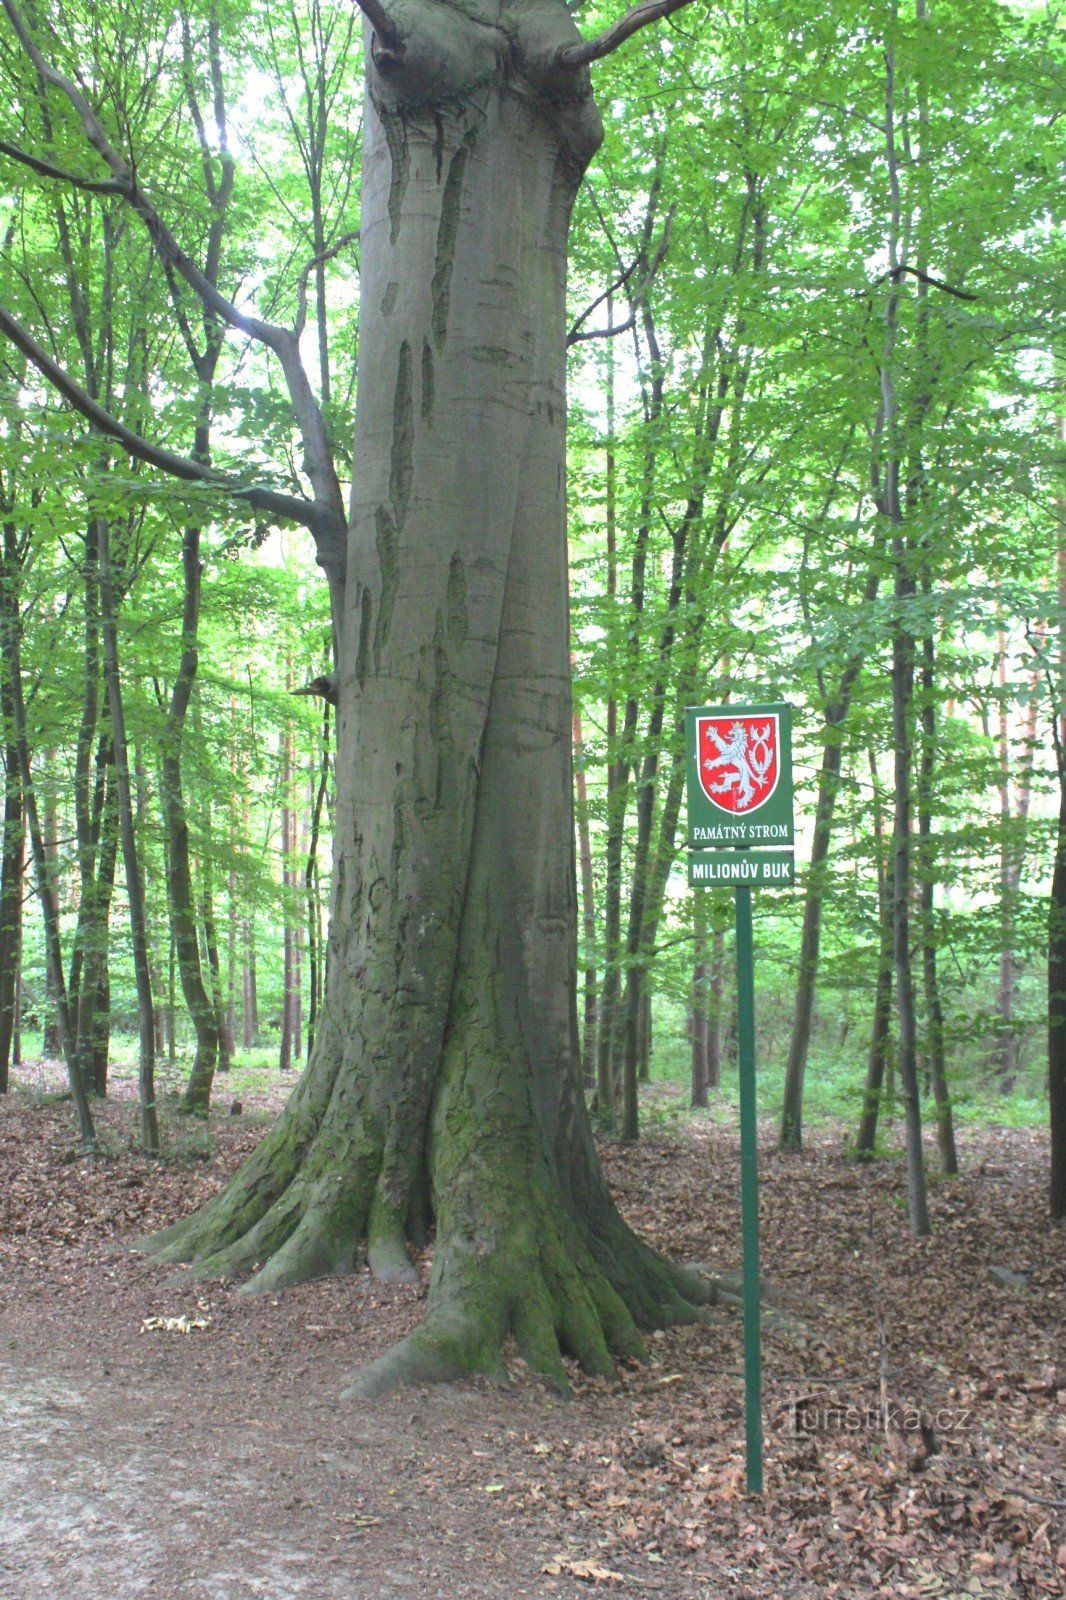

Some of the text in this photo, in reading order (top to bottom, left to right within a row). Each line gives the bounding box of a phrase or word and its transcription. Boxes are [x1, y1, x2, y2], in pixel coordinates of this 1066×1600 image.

[693, 822, 788, 840] PAMÁTNÝ STROM
[692, 859, 790, 879] MILIONŮV BUK
